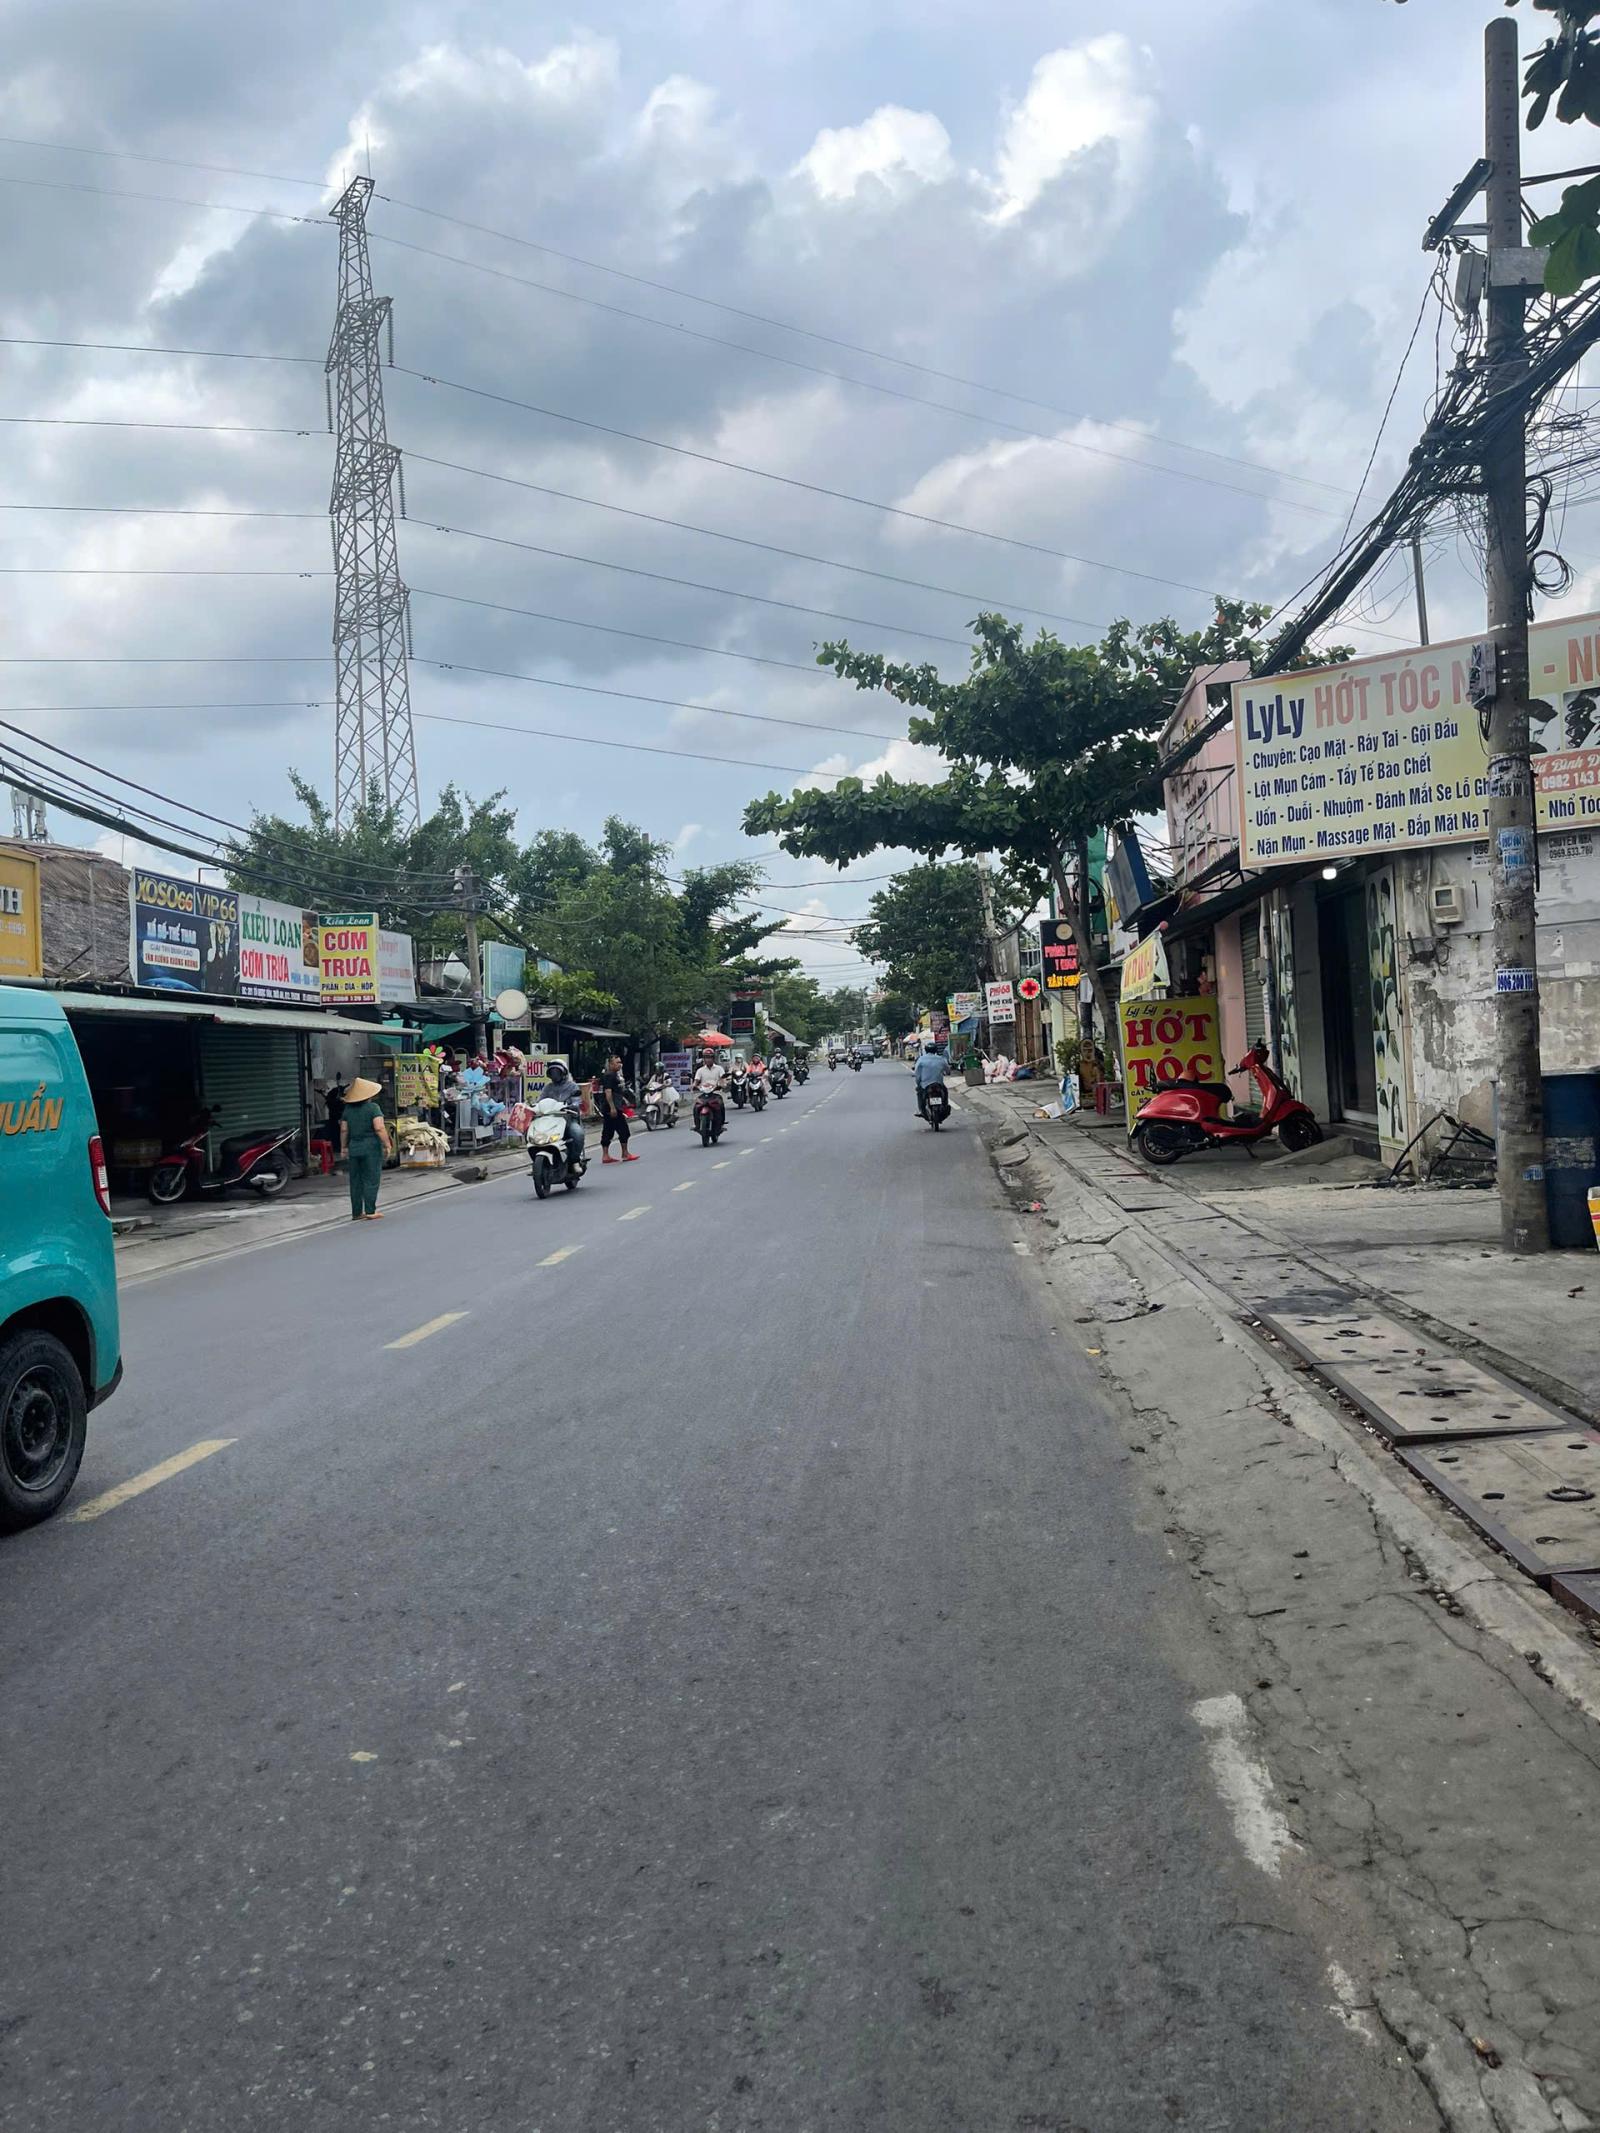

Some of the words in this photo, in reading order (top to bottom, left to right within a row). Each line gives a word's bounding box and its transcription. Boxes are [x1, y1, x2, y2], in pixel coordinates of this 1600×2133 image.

[1246, 694, 1304, 744] LyLy
[1315, 672, 1370, 728] HỚT
[1380, 660, 1440, 716] TÓC
[1253, 748, 1296, 769] Chuyên:
[1300, 745, 1320, 764] Cạo
[1324, 738, 1346, 760] Mặt
[1382, 729, 1399, 748] Tai
[1411, 724, 1431, 746] Gội
[1434, 717, 1458, 740] Đầu
[1254, 780, 1271, 800] Lột
[1273, 778, 1297, 797] Mụn
[1301, 773, 1326, 791] Cám
[1360, 760, 1374, 782] Tế
[1377, 761, 1400, 780] Bào
[1404, 752, 1431, 775] Chết
[1256, 806, 1277, 827] Uốn
[1287, 801, 1312, 822] Duỗi
[1323, 796, 1364, 818] Nhuộm
[1376, 790, 1405, 810] Đánh
[1409, 782, 1433, 805] Mắt
[1436, 783, 1452, 801] Se
[1456, 776, 1470, 799] Lỗ
[1474, 778, 1489, 796] Gh
[1257, 837, 1278, 858] Nặn
[1282, 835, 1306, 854] Mụn
[1317, 827, 1369, 847] Massage
[1373, 821, 1396, 843] Mặt
[1435, 812, 1458, 835] Mặt
[1462, 811, 1479, 832] Nạ
[1549, 793, 1575, 818] Nhổ
[273, 917, 302, 949] LOAN
[324, 930, 368, 951] CƠM
[321, 956, 372, 977] TRƯA
[1125, 1008, 1212, 1048] HỚT
[1127, 1048, 1213, 1088] TÓC
